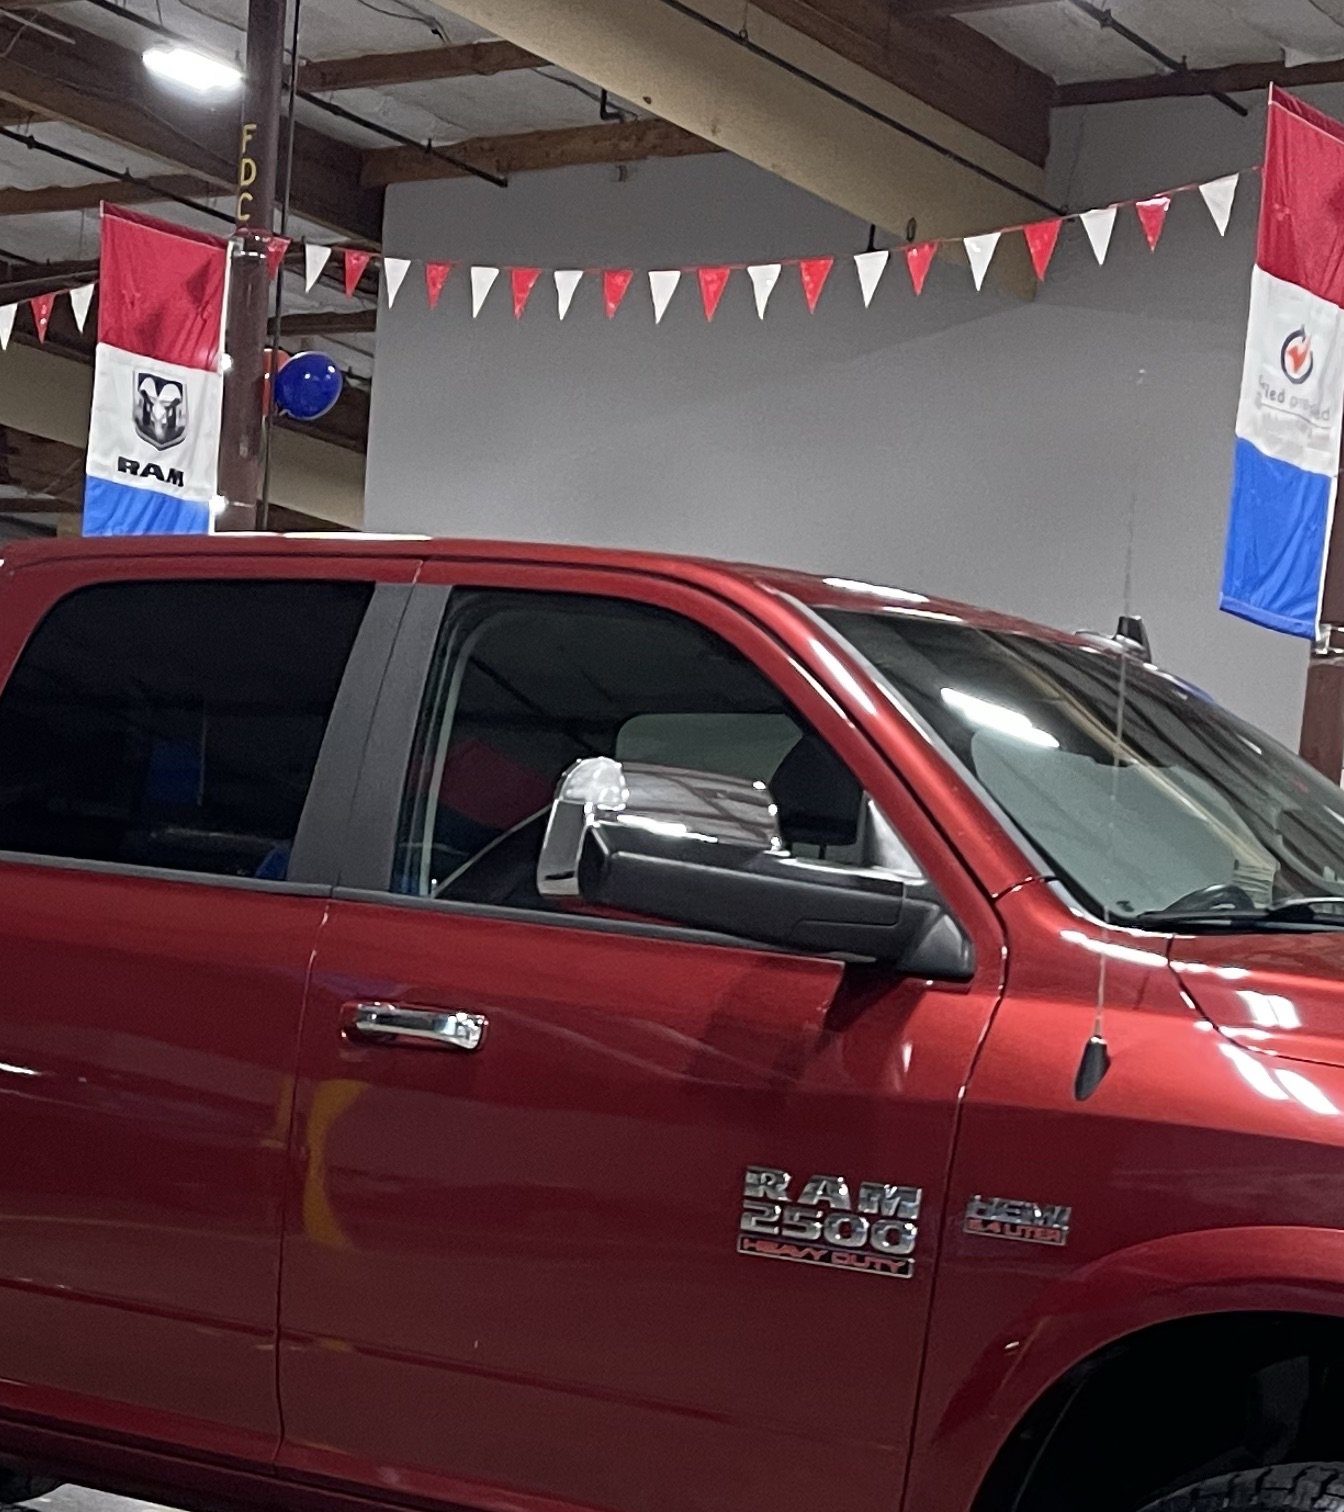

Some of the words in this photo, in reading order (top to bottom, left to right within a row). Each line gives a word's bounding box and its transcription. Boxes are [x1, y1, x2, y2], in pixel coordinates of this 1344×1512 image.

[236, 122, 257, 222] FDC
[117, 455, 185, 488] RAM
[743, 1165, 923, 1220] RAM
[740, 1199, 918, 1255] 2500
[742, 1238, 828, 1262] HEAVY
[830, 1251, 906, 1274] DUTY
